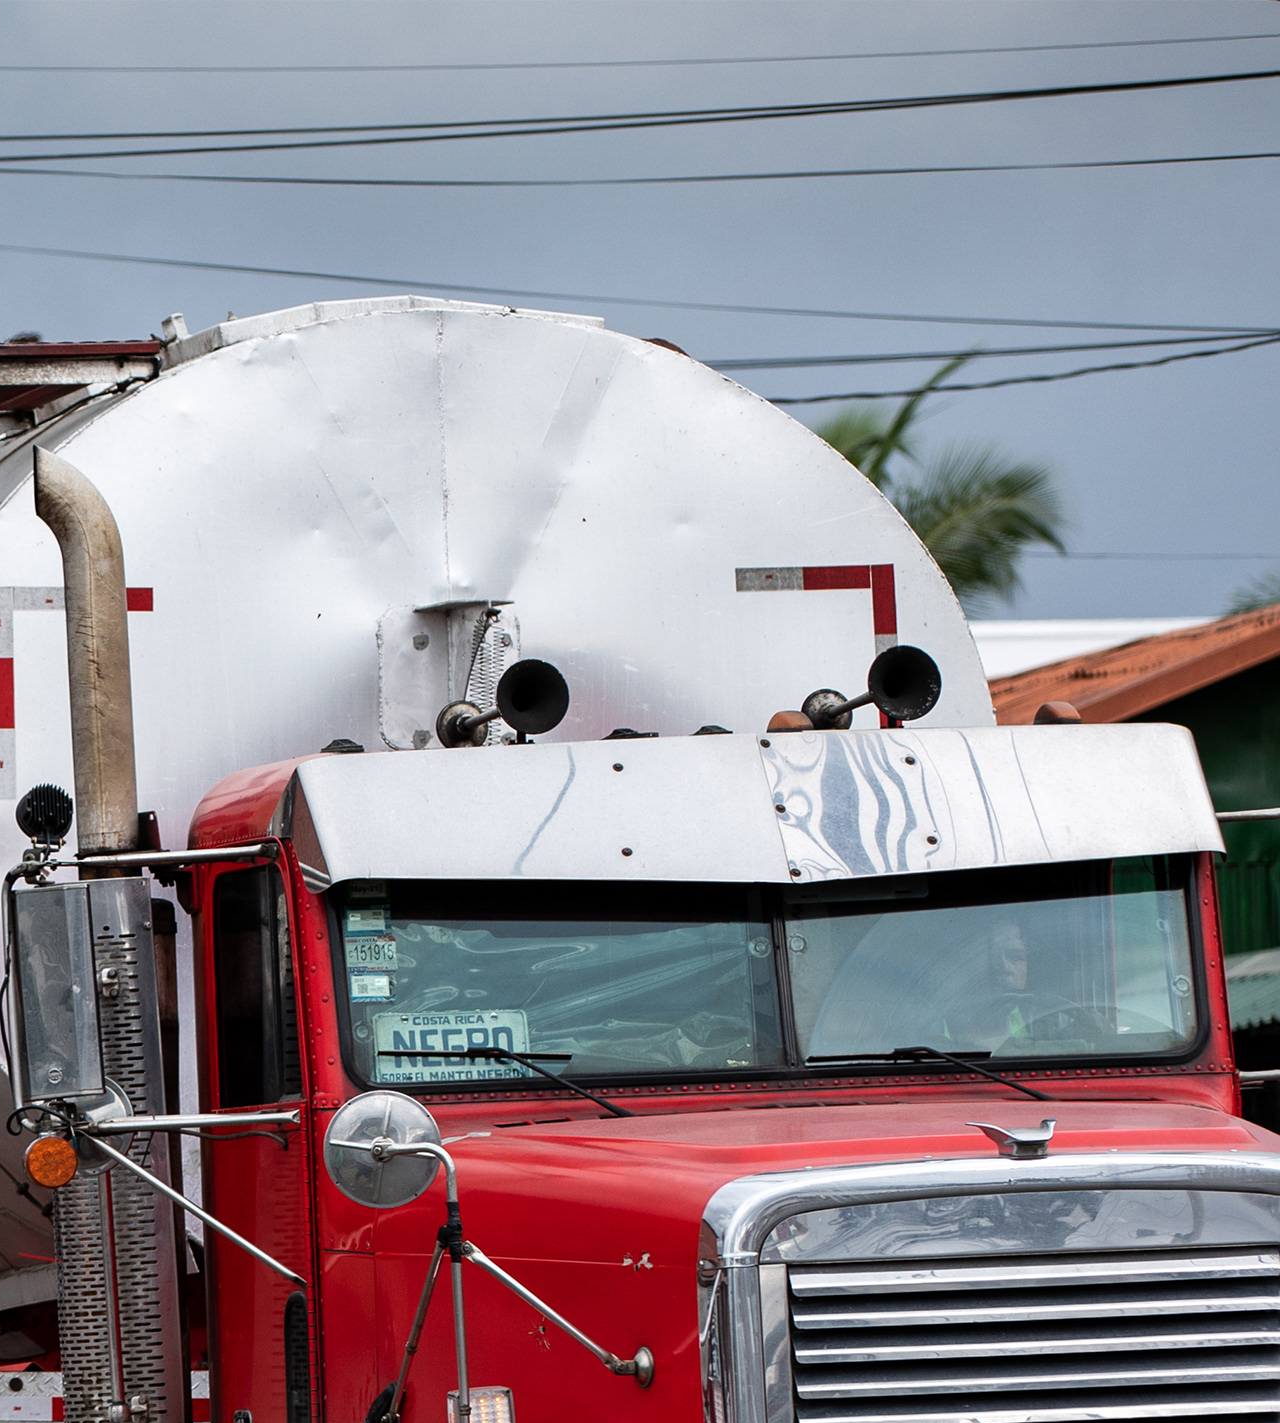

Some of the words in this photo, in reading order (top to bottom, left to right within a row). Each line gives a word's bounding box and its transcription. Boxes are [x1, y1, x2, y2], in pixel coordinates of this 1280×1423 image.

[413, 1016, 450, 1026] COSTA
[455, 1015, 485, 1025] RICA
[393, 1026, 515, 1068] NEGRO
[429, 1070, 472, 1080] MANTO
